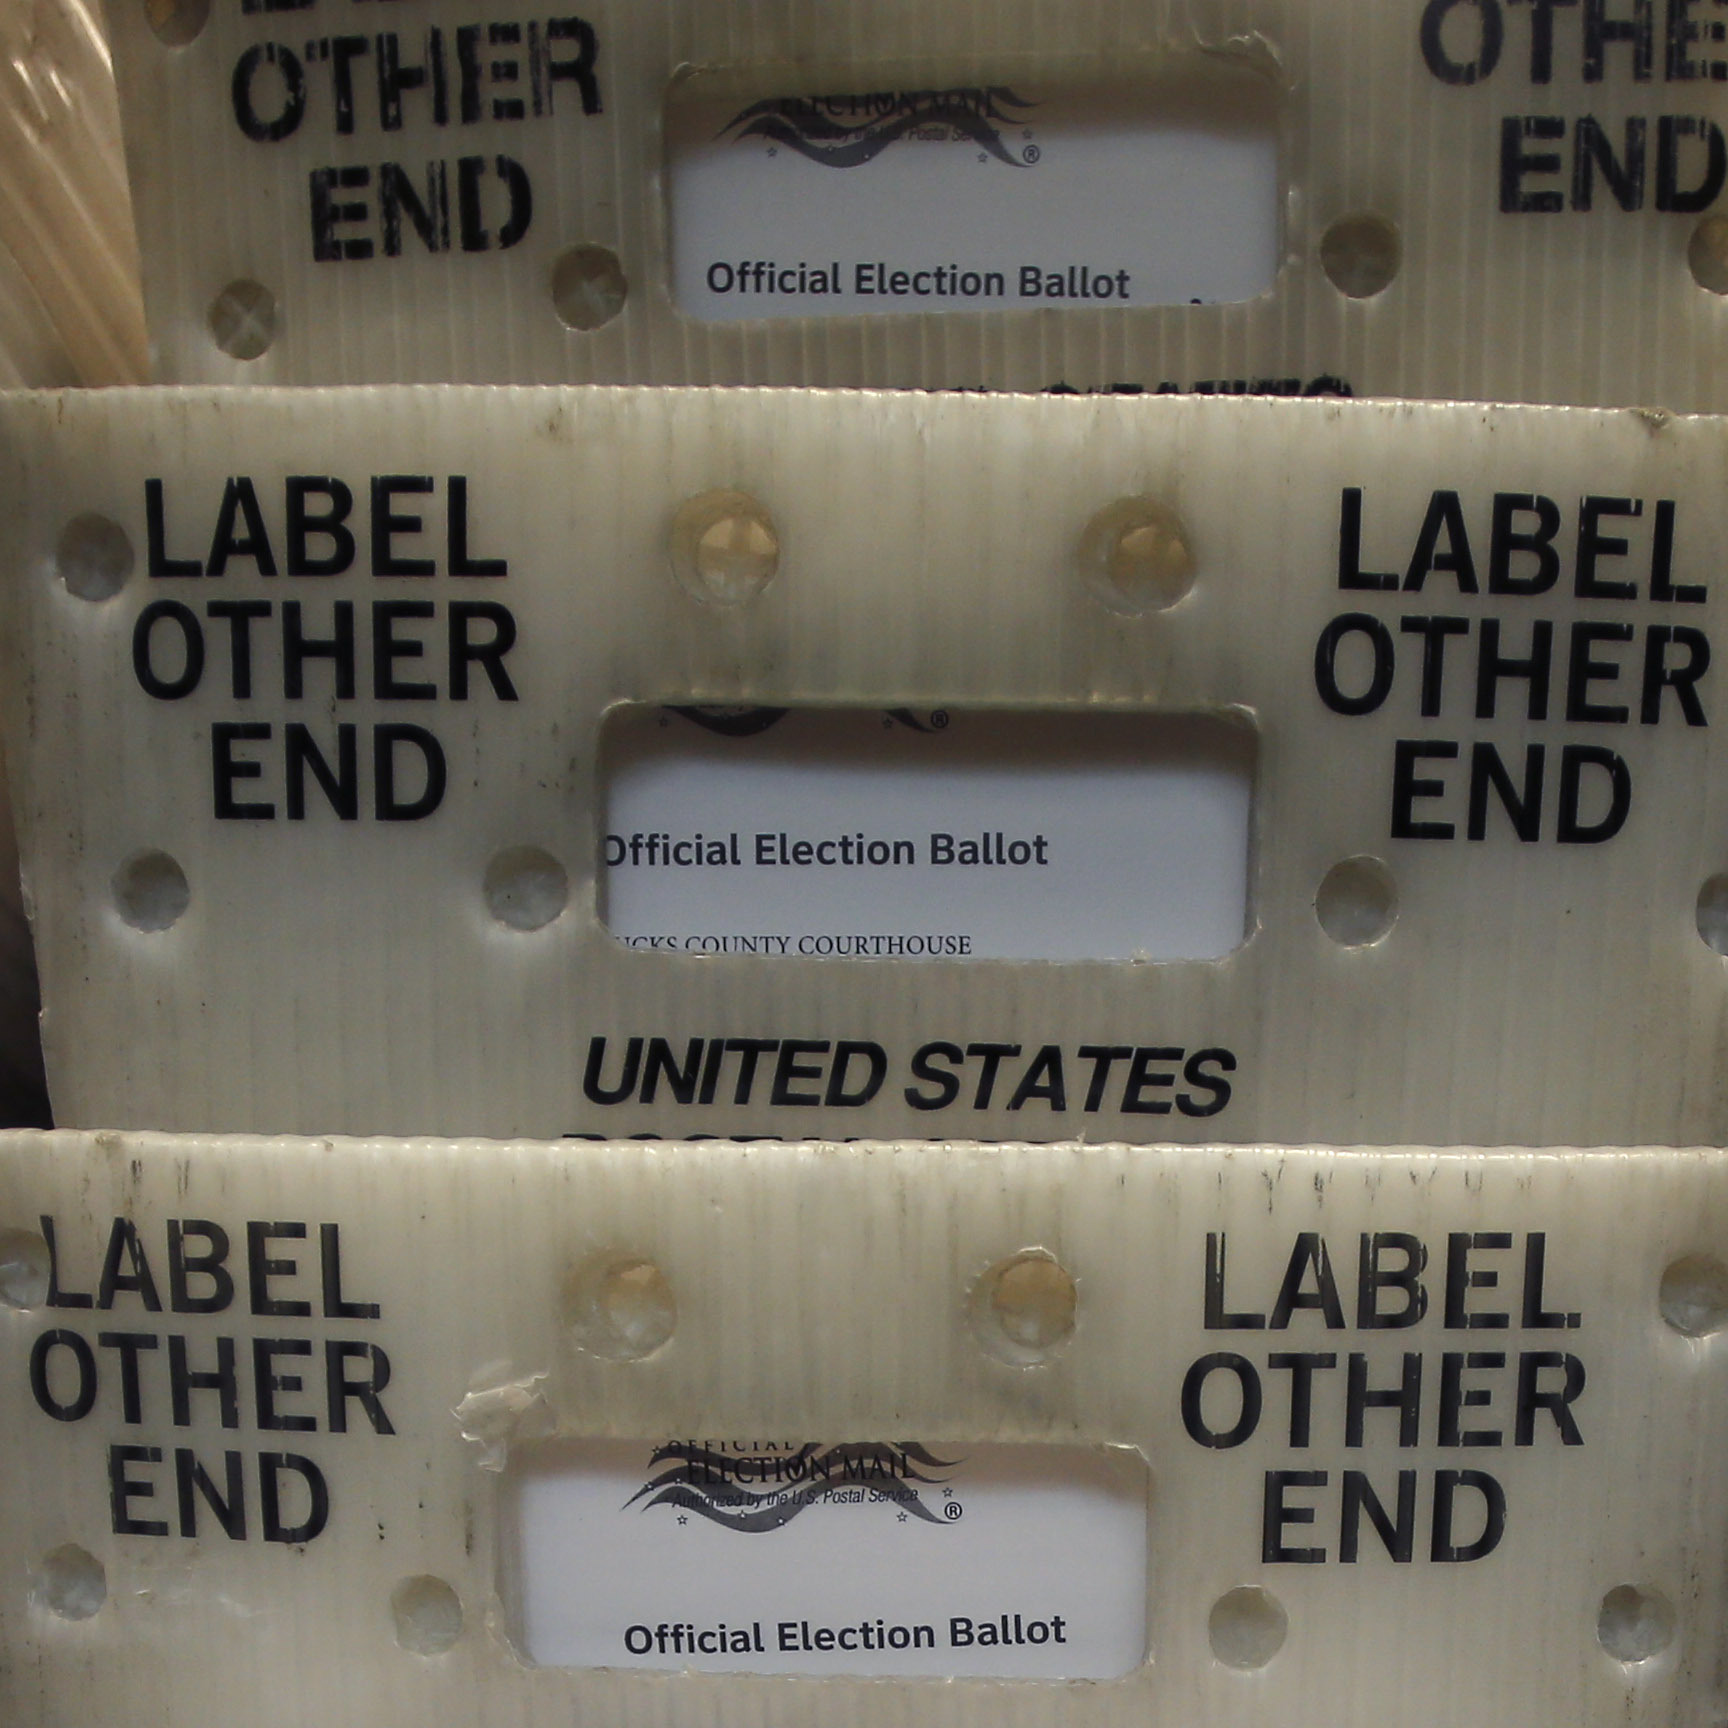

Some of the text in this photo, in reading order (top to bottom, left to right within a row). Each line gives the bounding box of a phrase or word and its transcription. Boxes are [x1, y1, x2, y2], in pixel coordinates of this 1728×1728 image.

[231, 16, 606, 144] OTHER
[308, 154, 537, 263] END
[1498, 115, 1728, 211] END
[706, 262, 1130, 298] Official Election Ballot
[143, 474, 508, 581] LABEL
[1338, 490, 1706, 604] LABEL
[132, 597, 518, 705] OTHER
[1312, 617, 1711, 730] OTHER
[210, 721, 447, 826] END
[1392, 740, 1634, 846] END
[755, 832, 1048, 866] Election Ballot
[798, 936, 972, 956] COURTHOUSE
[583, 1037, 1236, 1118] UNITED STATES
[40, 1213, 382, 1320] LABEL
[1202, 1232, 1582, 1332] LABEL
[30, 1334, 396, 1437] OTHER
[1182, 1349, 1587, 1449] OTHER
[107, 1447, 331, 1545] END
[687, 1453, 915, 1485] ELECTION MAIL
[1261, 1468, 1506, 1564] END
[624, 1614, 1066, 1654] Official Election Ballot
